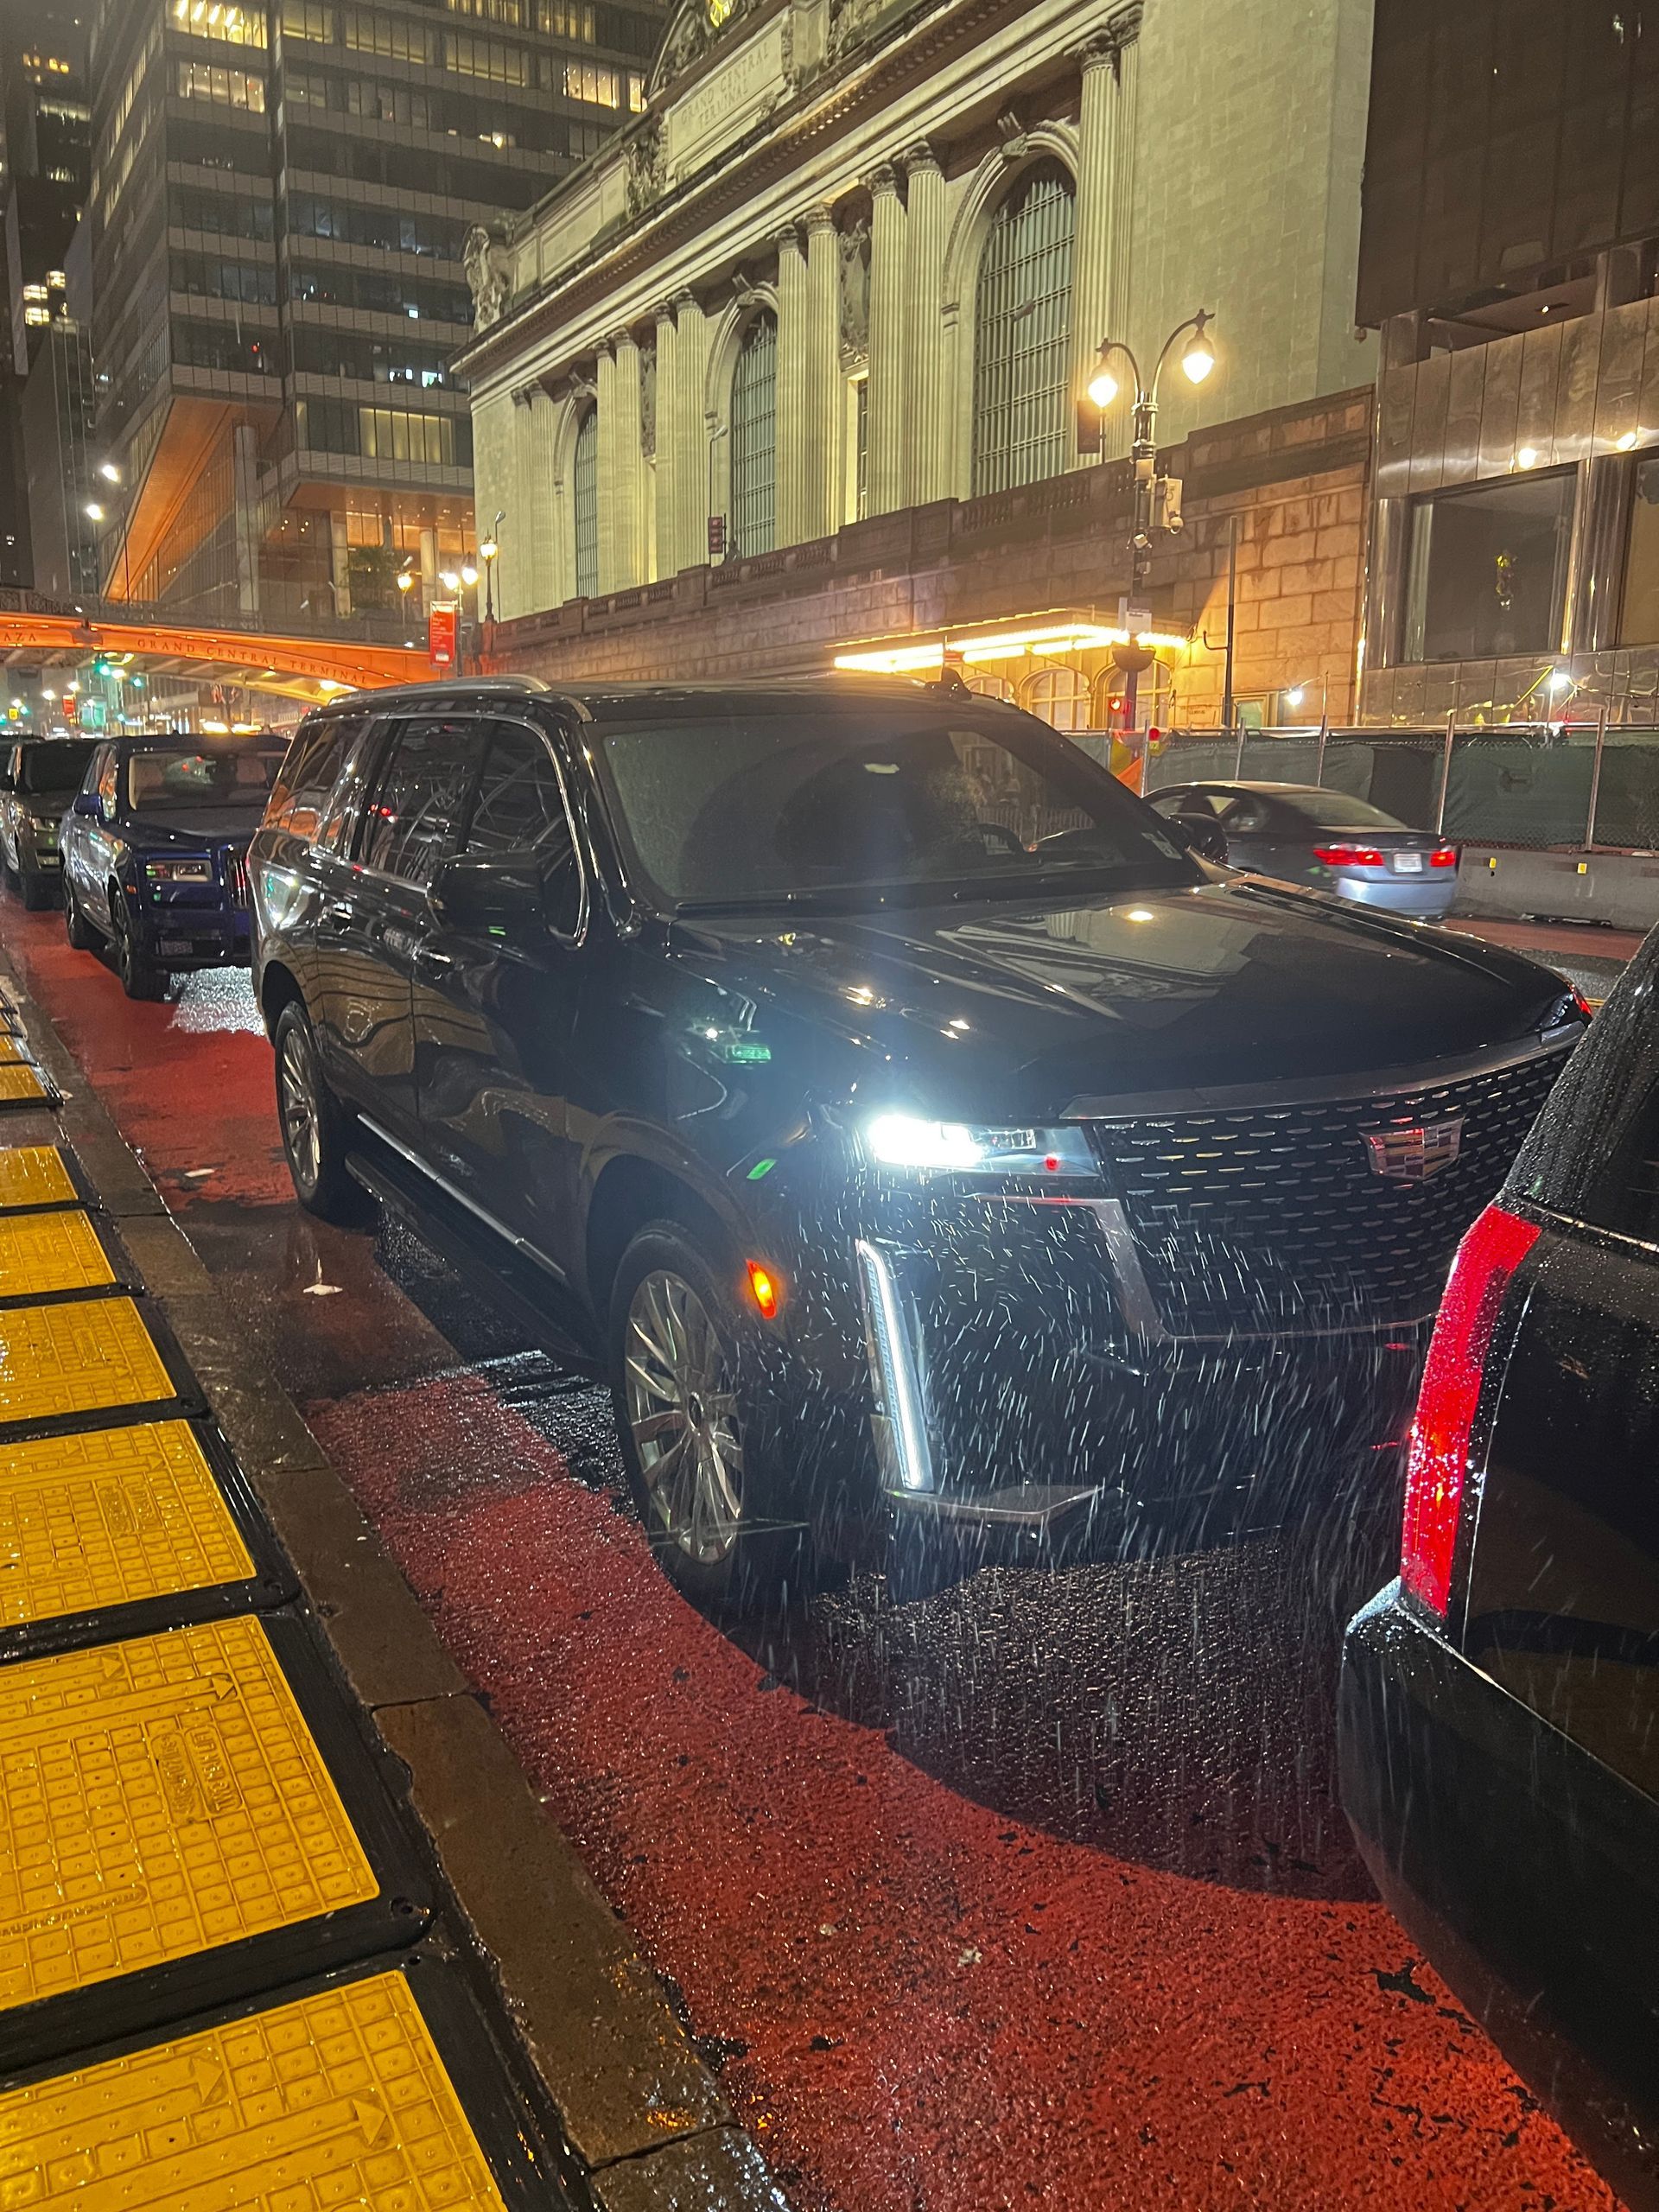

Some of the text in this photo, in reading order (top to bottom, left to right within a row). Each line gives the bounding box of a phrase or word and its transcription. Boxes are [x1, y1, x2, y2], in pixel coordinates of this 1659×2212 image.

[681, 41, 768, 125] GRAND CENTRAL
[698, 78, 748, 130] TERMINAL
[137, 639, 366, 684] GRAND CENTRAL TERMINAL
